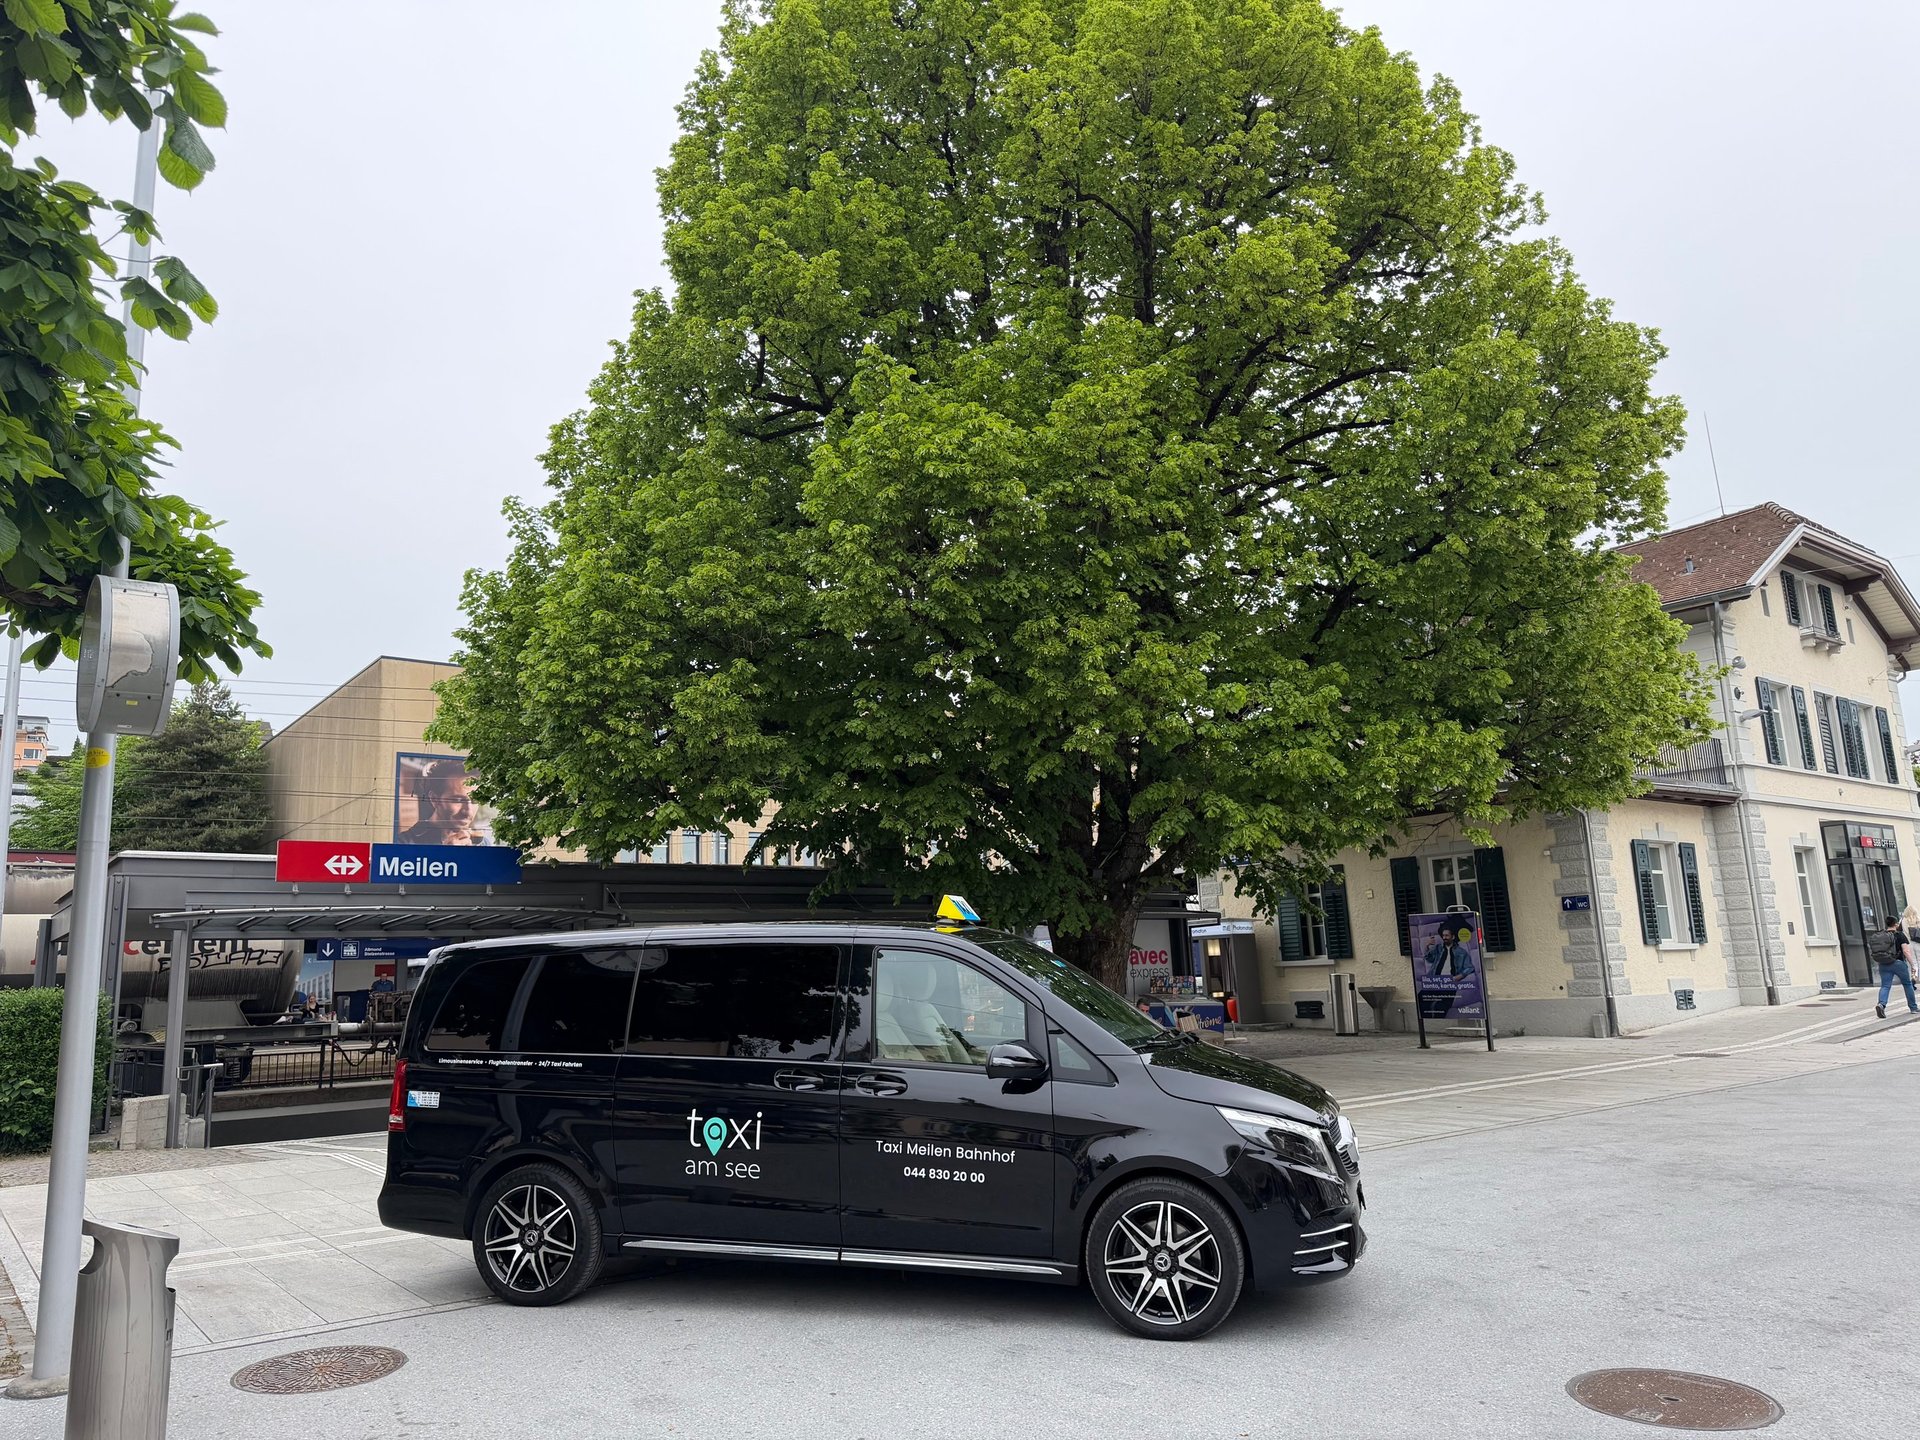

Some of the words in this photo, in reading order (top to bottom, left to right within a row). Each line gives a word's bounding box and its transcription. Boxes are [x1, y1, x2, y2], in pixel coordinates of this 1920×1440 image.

[379, 856, 458, 877] Meilen
[1129, 949, 1169, 965] avec
[1130, 967, 1170, 980] express
[686, 1108, 763, 1151] taxi
[876, 1140, 903, 1154] Taxi
[906, 1142, 952, 1158] Meilen
[956, 1146, 1016, 1163] Bahnhof
[685, 1159, 718, 1176] am
[725, 1162, 761, 1179] see
[903, 1166, 926, 1178] 044
[928, 1168, 951, 1180] 830
[953, 1170, 967, 1182] 20
[970, 1172, 985, 1183] 00
